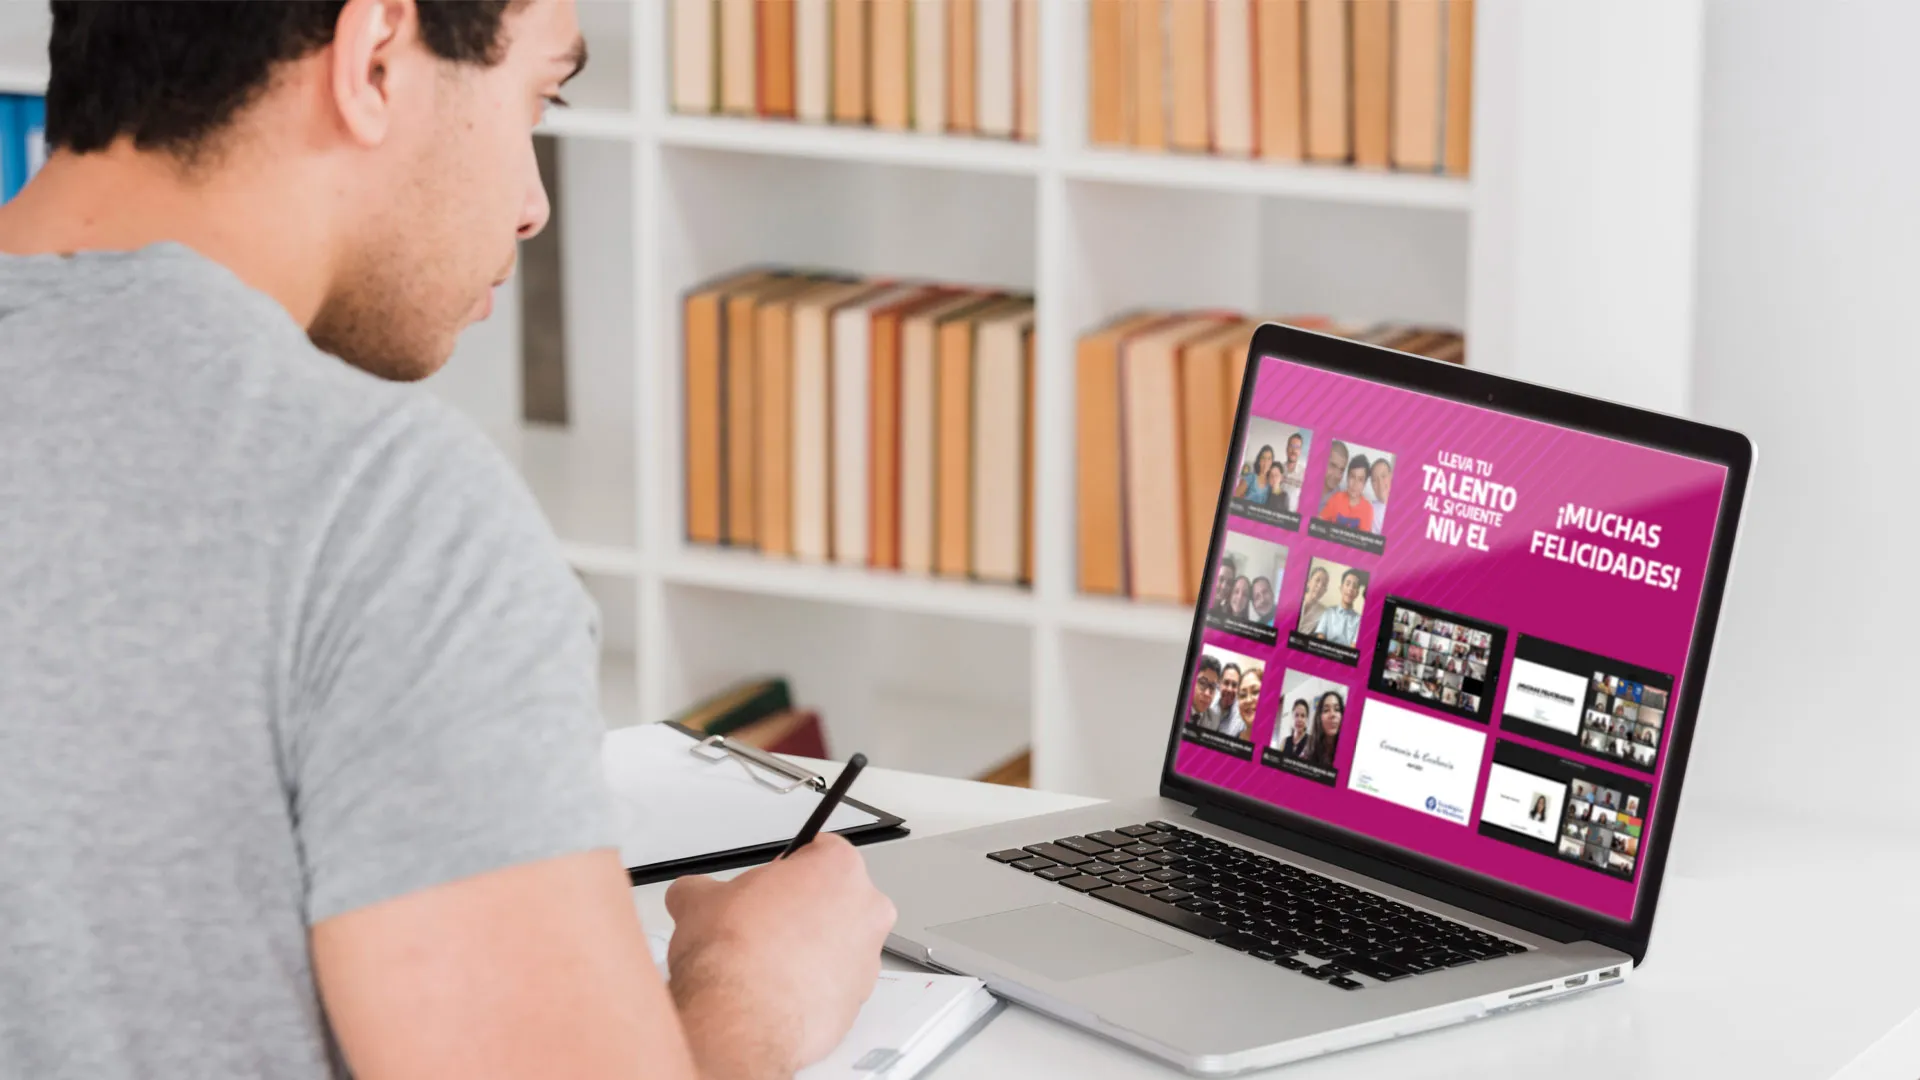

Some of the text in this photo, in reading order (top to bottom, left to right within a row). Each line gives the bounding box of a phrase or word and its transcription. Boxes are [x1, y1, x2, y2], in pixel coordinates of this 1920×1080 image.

[1437, 450, 1493, 477] LLEVA TU
[1421, 464, 1517, 513] TALENTO
[1423, 494, 1440, 513] AL
[1556, 503, 1662, 548] ¡MUCHAS
[1529, 530, 1682, 591] FELICIDADES!
